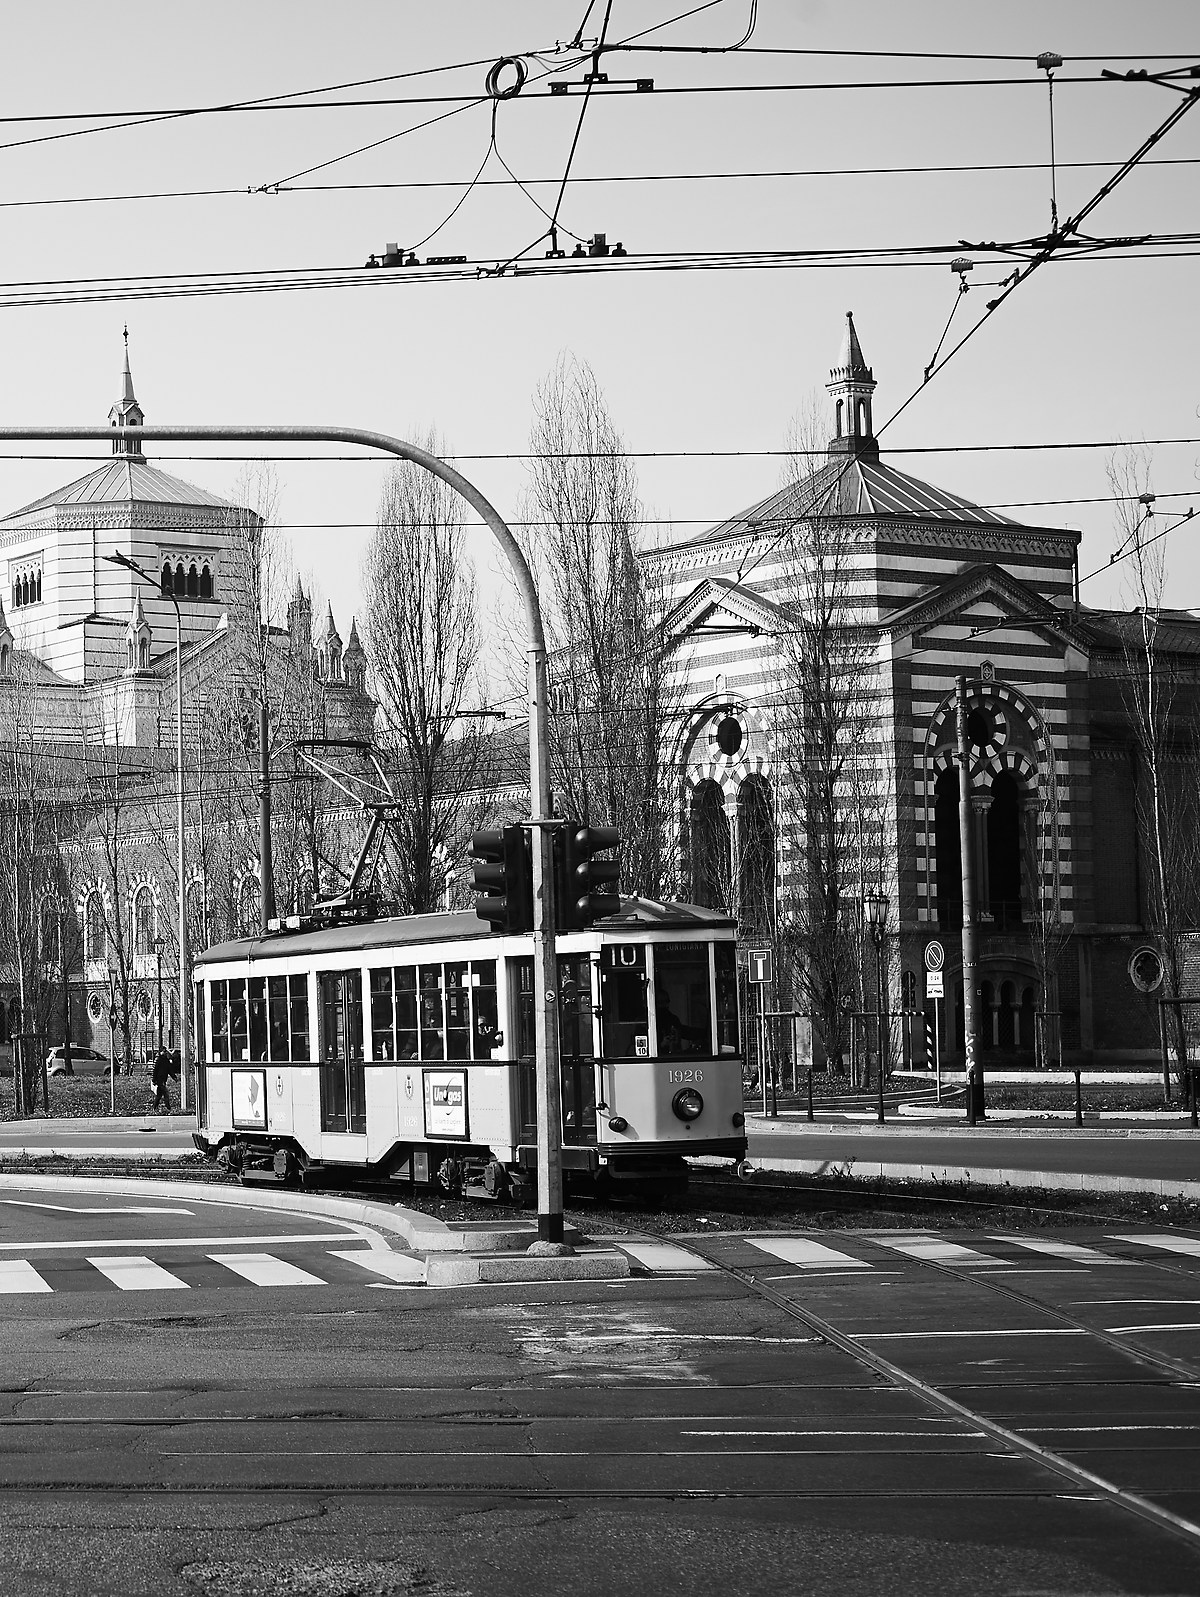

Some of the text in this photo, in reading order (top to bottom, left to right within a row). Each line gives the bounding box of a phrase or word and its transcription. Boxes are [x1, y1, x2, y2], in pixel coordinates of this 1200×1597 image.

[610, 945, 636, 966] 10
[638, 1047, 646, 1055] 10
[668, 1069, 703, 1083] 1926
